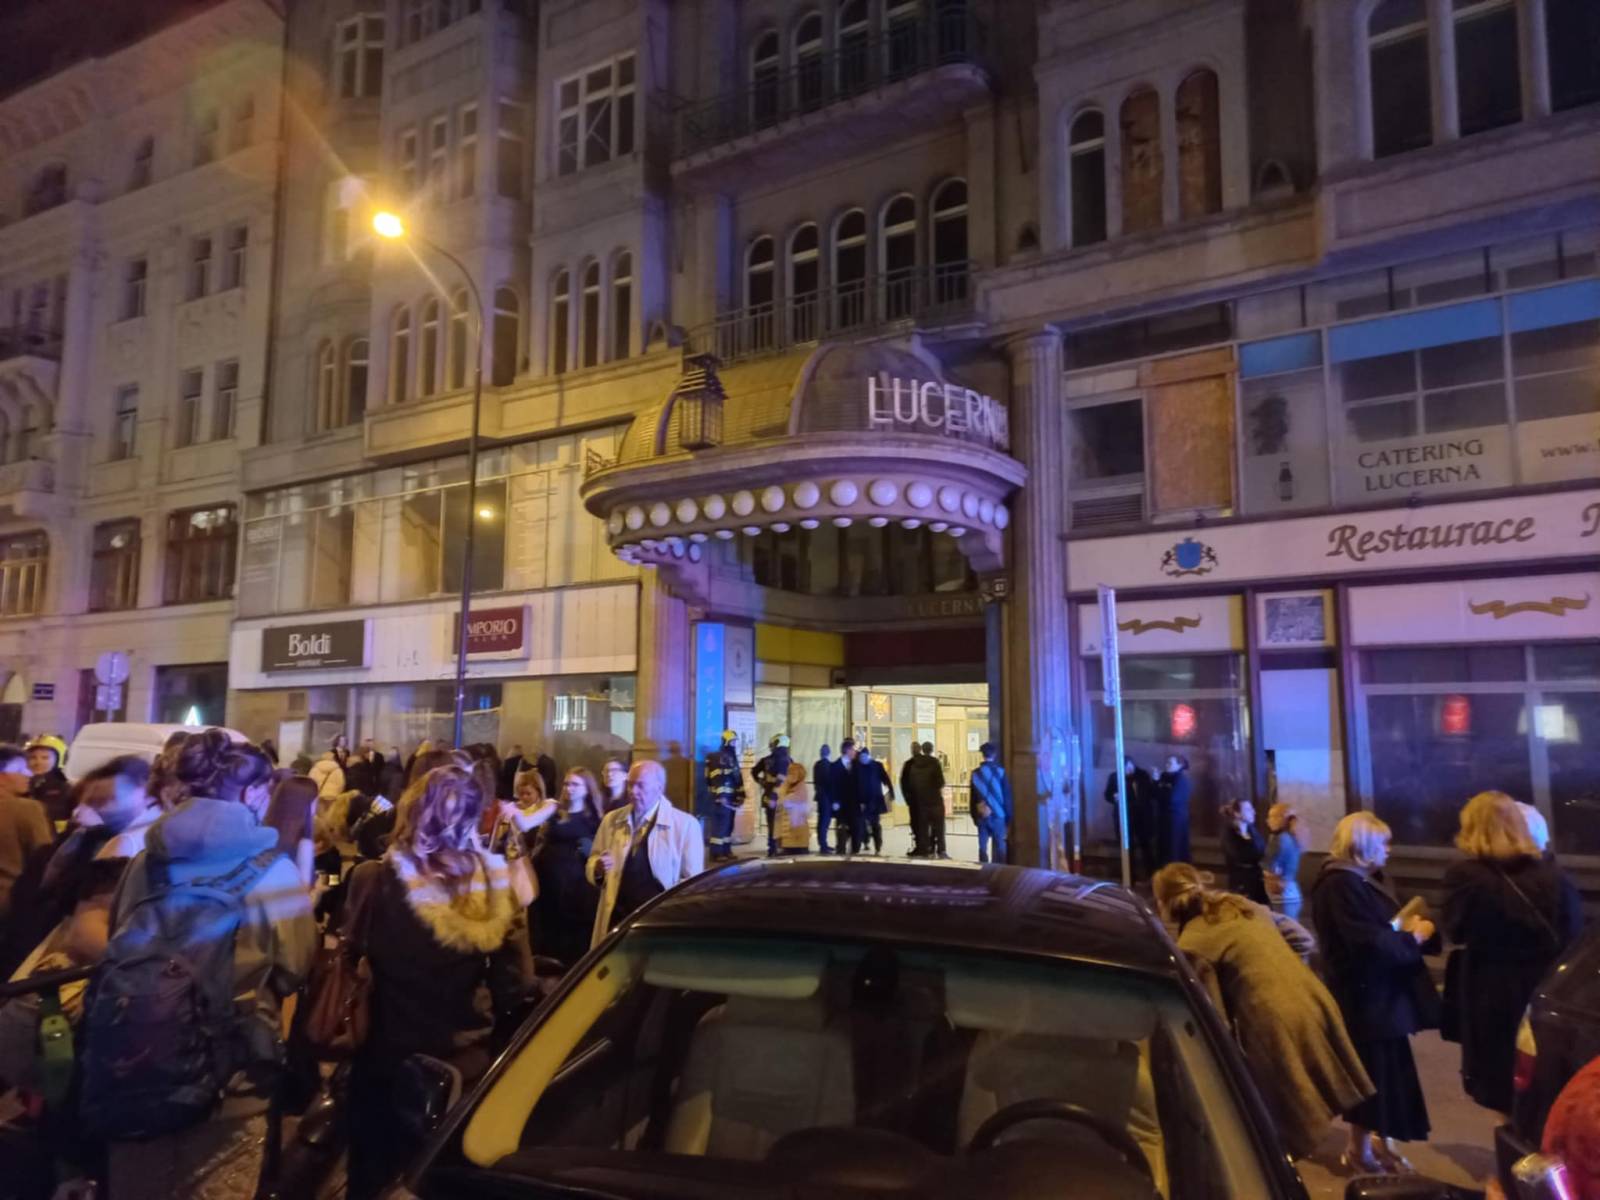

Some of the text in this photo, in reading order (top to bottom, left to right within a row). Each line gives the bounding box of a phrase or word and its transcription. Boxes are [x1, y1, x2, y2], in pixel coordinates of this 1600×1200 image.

[1358, 439, 1484, 469] CATERING
[1365, 464, 1481, 491] LUCERNA
[1326, 517, 1536, 562] Restaurace
[467, 618, 517, 635] MPORIO
[288, 633, 331, 656] Boldi
